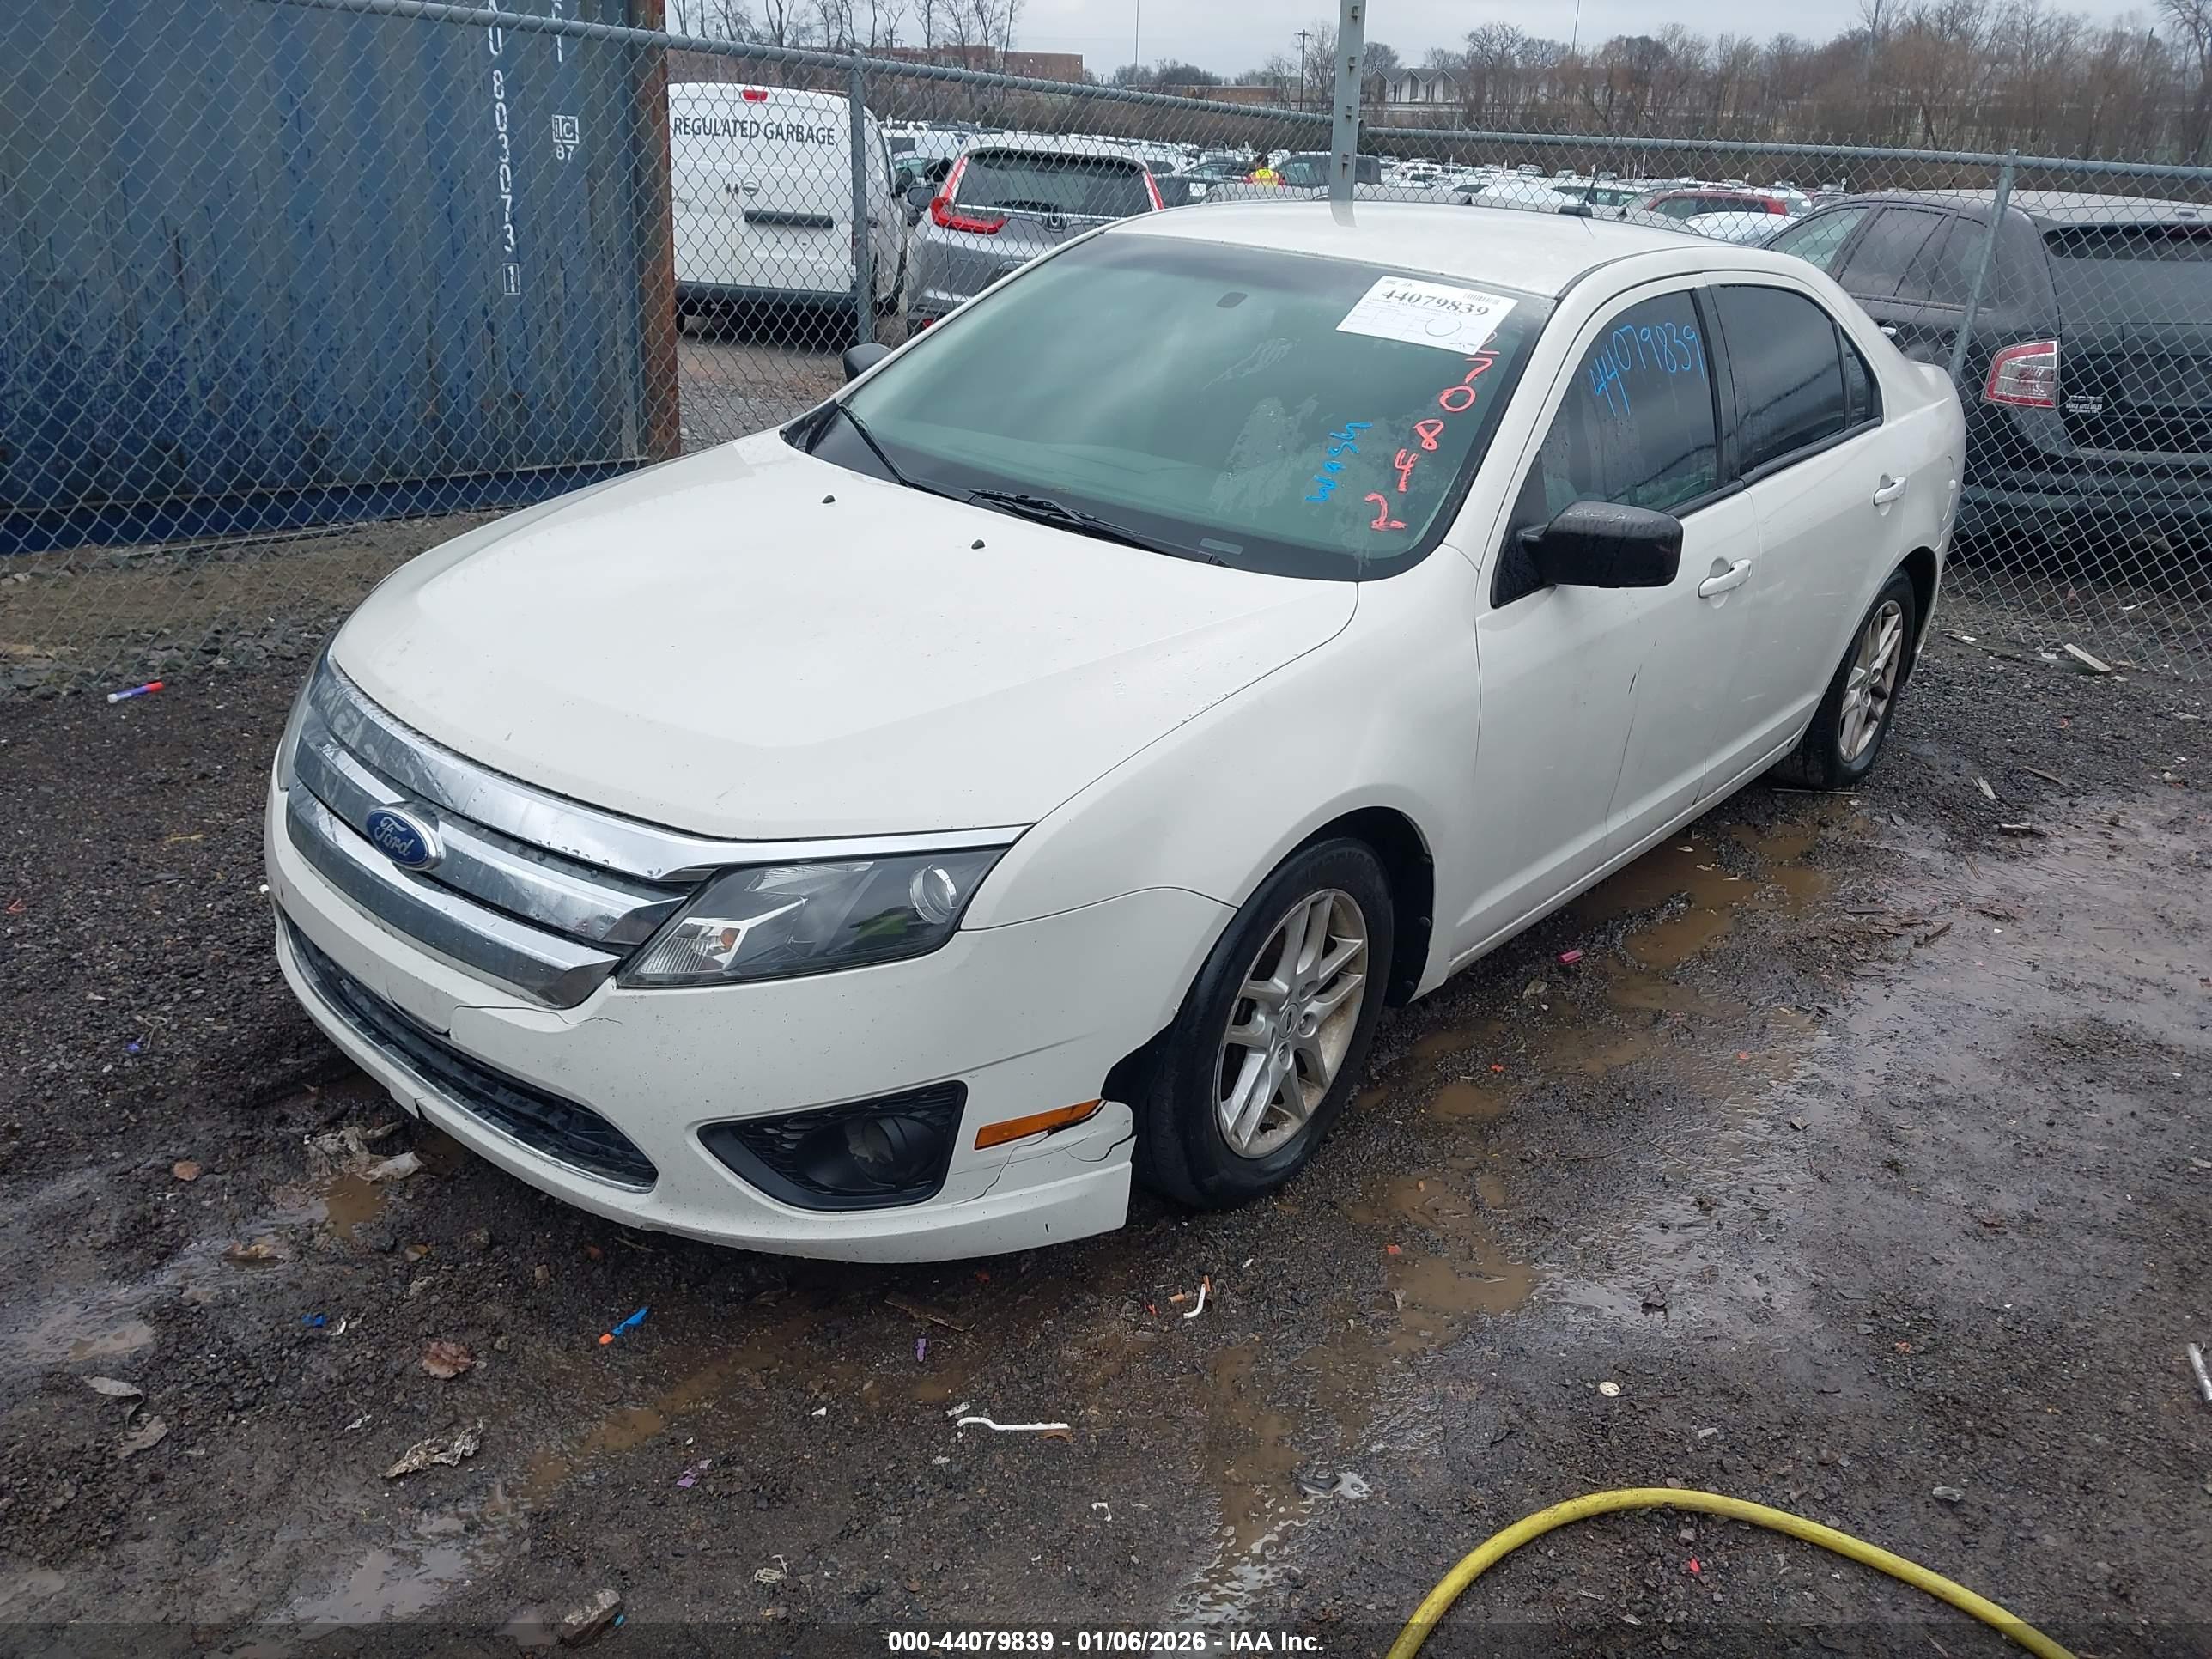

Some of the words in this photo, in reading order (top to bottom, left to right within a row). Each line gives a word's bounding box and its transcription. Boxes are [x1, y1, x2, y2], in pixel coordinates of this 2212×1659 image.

[674, 118, 759, 138] REGULATED
[764, 122, 836, 145] GARBAGE
[556, 144, 574, 161] 87
[1381, 289, 1491, 317] 44079839
[1590, 323, 1705, 416] 44079839
[374, 816, 415, 857] Ford
